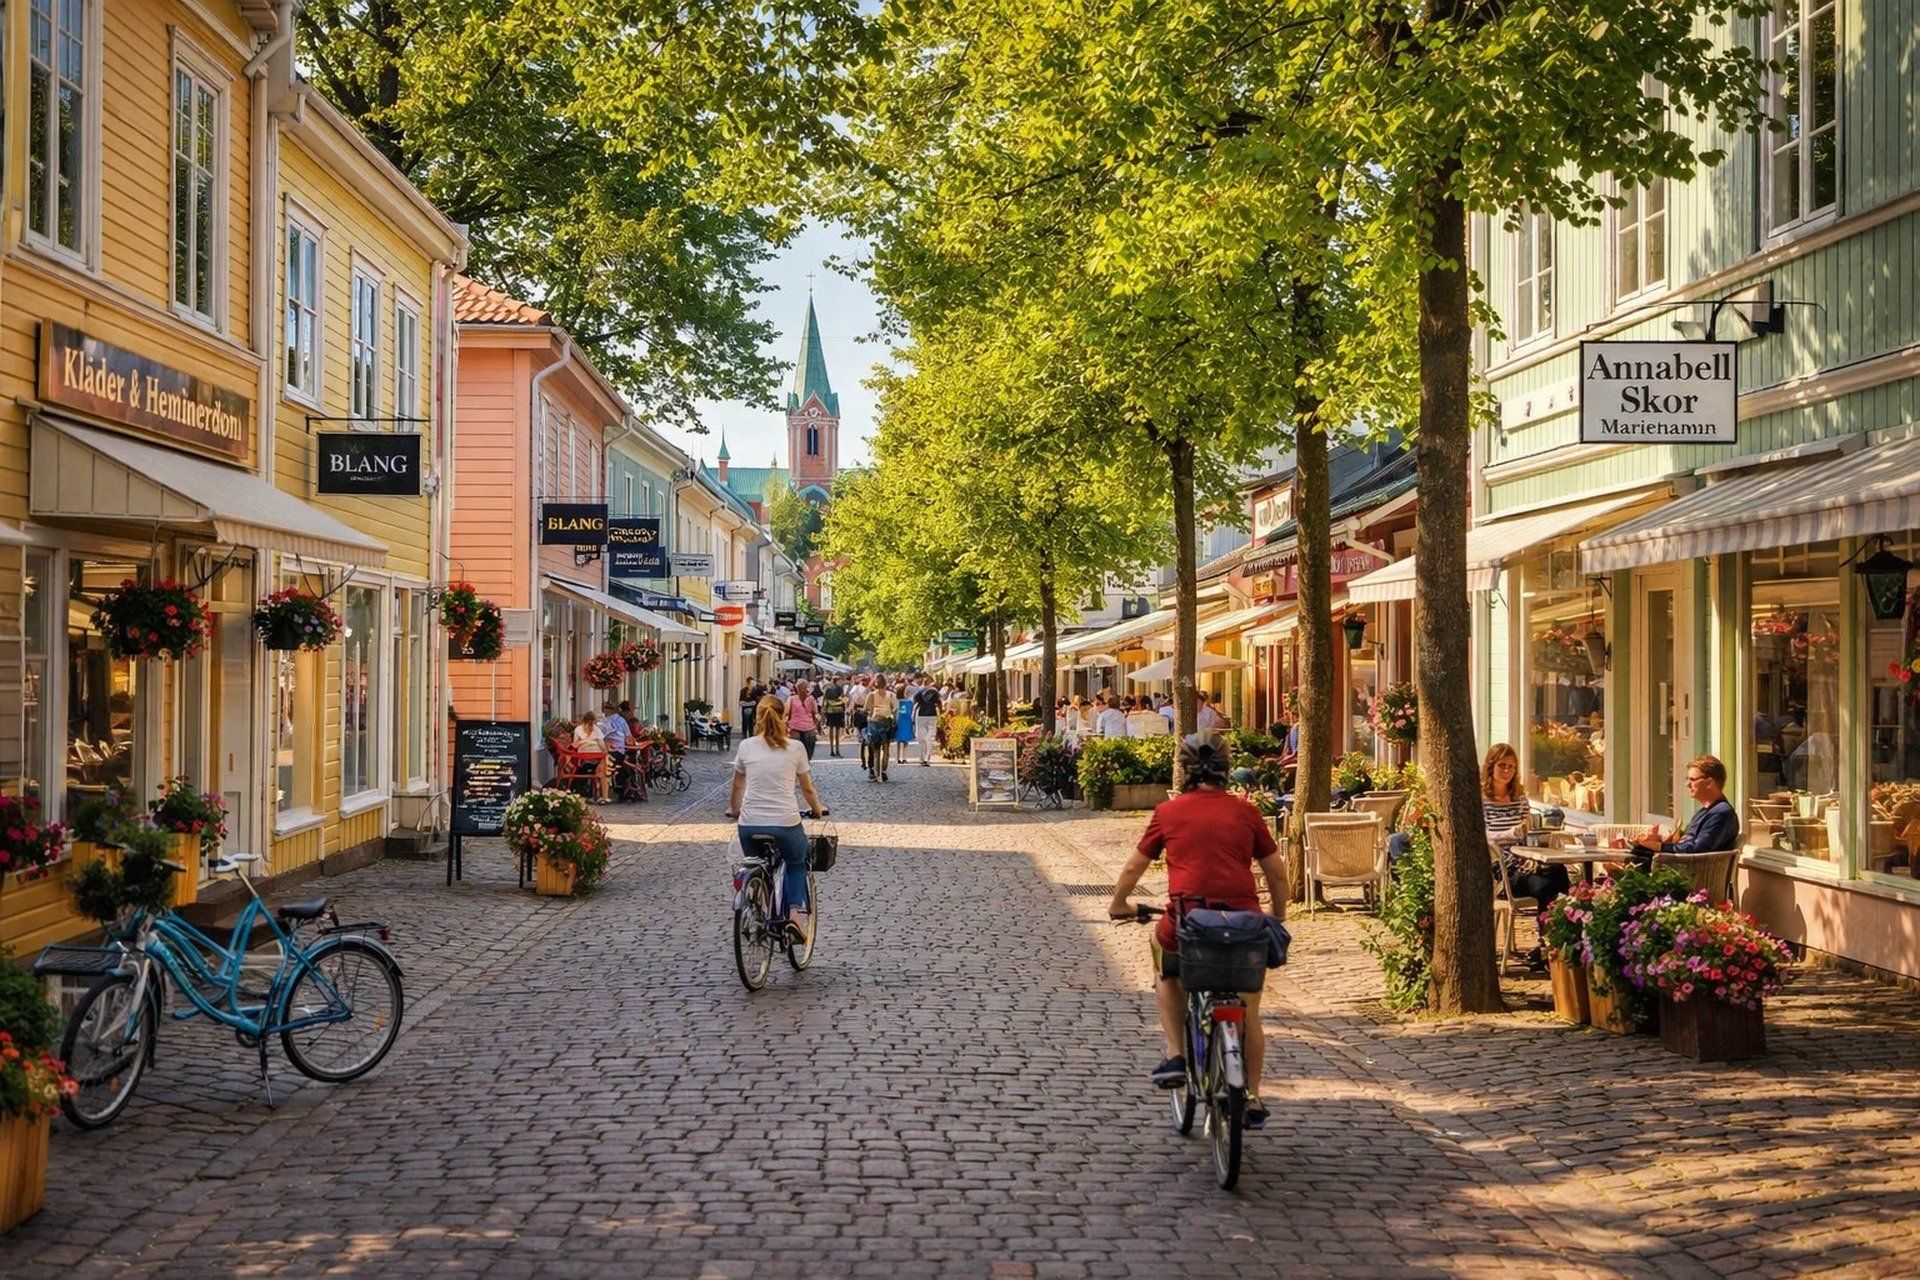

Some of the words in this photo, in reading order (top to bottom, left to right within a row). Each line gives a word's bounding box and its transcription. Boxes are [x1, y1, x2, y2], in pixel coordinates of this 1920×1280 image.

[1587, 352, 1732, 381] Annabell
[129, 369, 141, 409] &
[1620, 385, 1699, 414] Skor
[329, 453, 408, 474] BLANG
